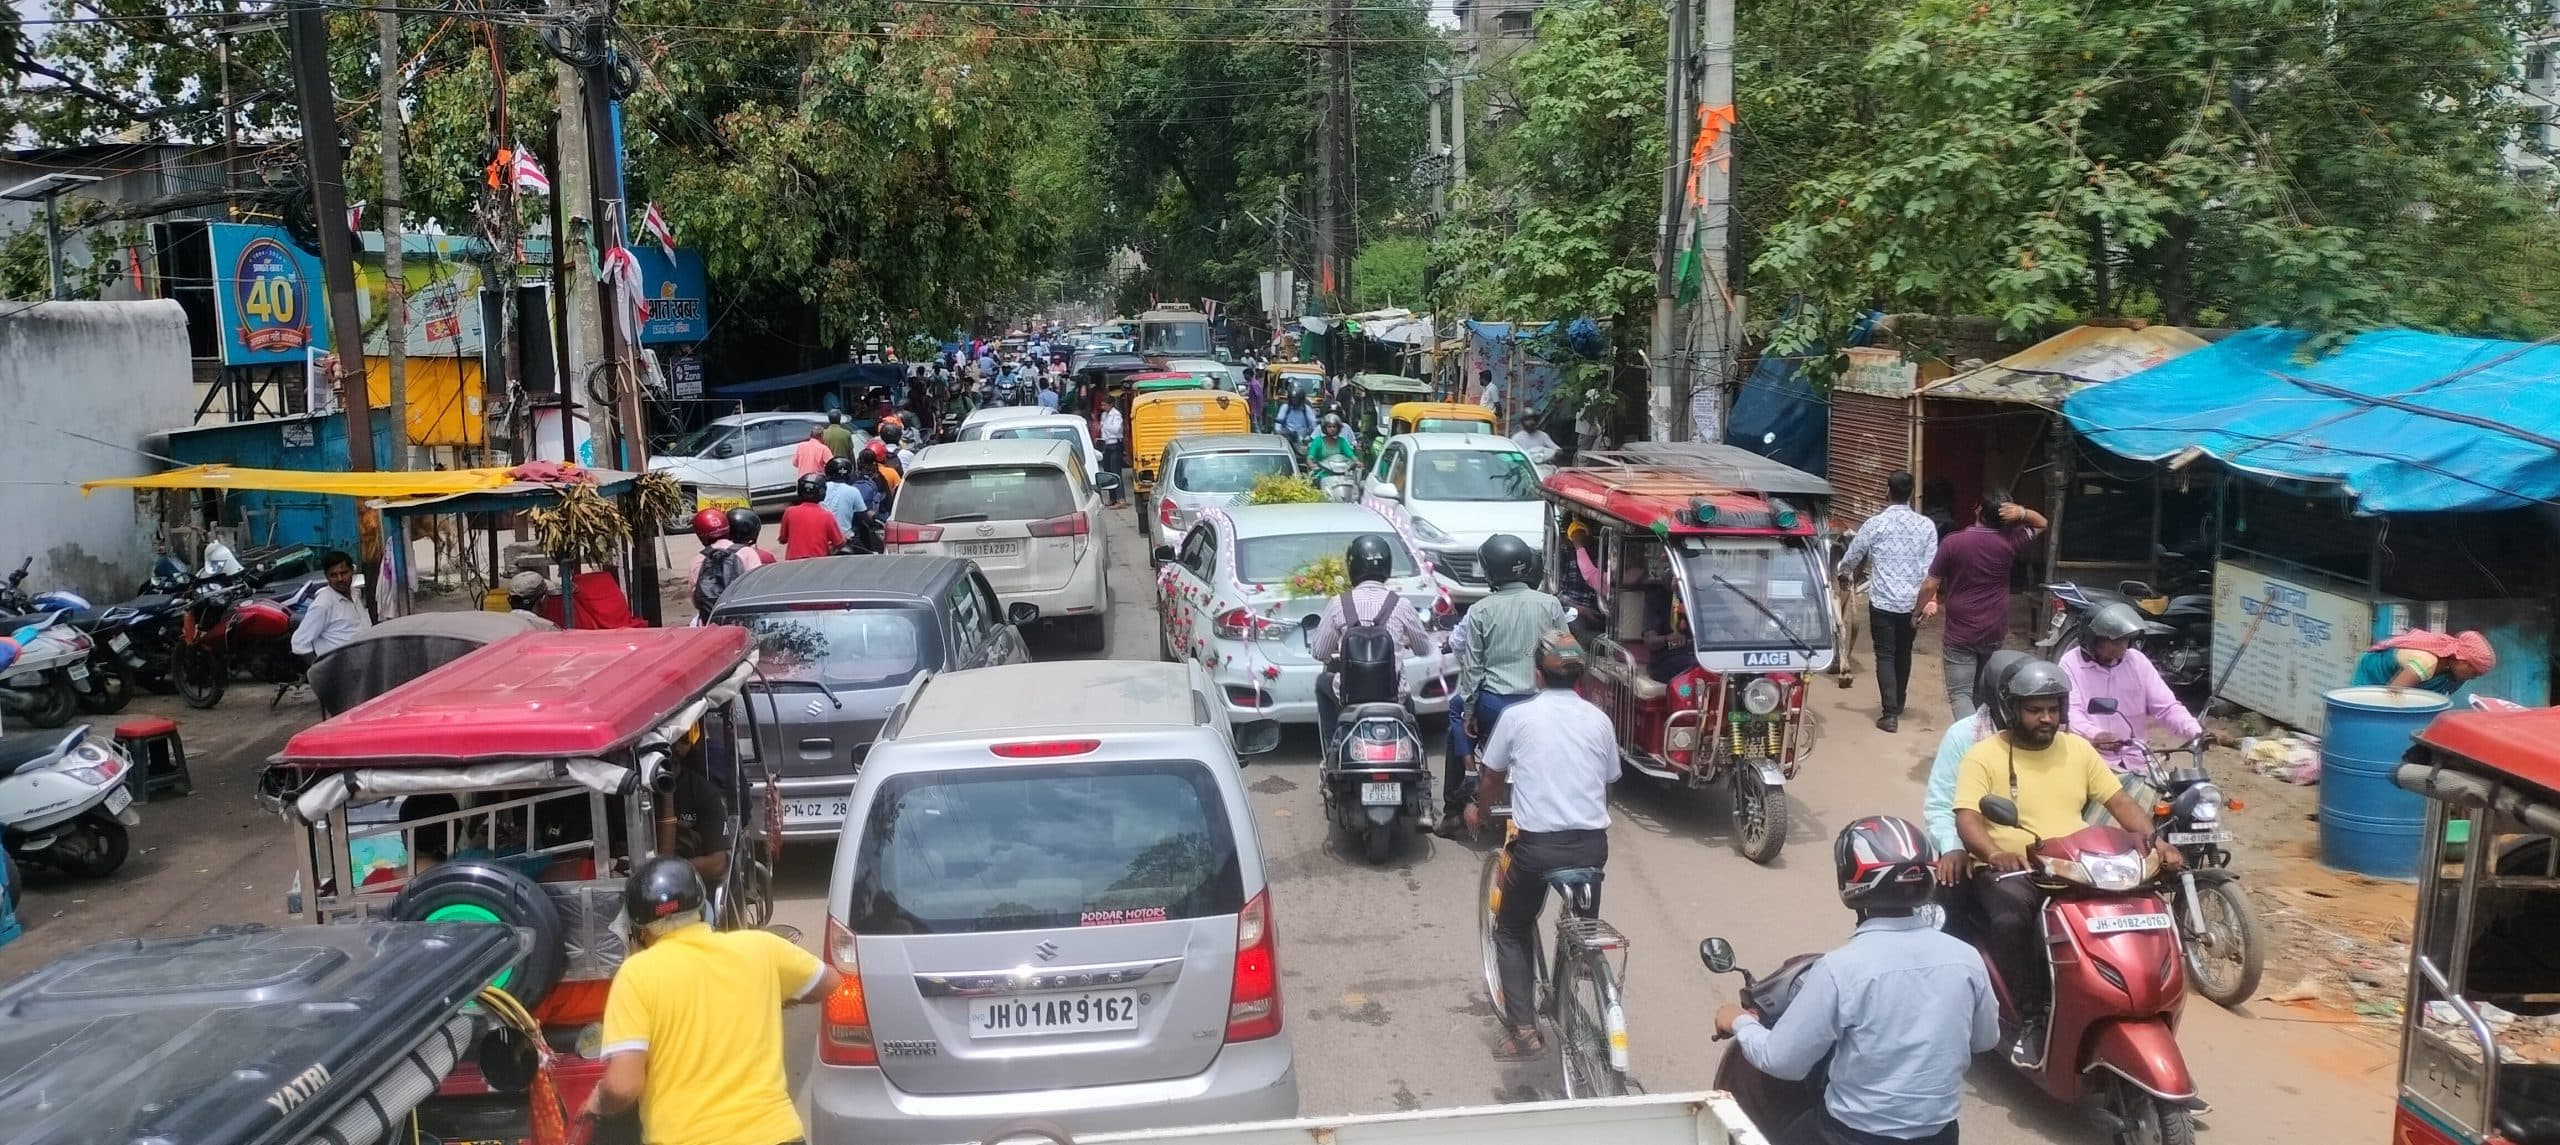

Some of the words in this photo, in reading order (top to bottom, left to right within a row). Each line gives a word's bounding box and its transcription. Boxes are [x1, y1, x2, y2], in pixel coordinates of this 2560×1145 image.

[246, 275, 294, 323] 40
[647, 298, 671, 320] भात
[671, 298, 701, 320] खबर
[1746, 653, 1788, 665] AAGE
[785, 802, 804, 816] P14
[807, 803, 822, 816] CZ
[1081, 909, 1122, 922] PODDAR
[1125, 906, 1166, 919] MOTORS
[984, 996, 1133, 1029] JH01AR9162
[265, 1062, 332, 1115] YATRI
